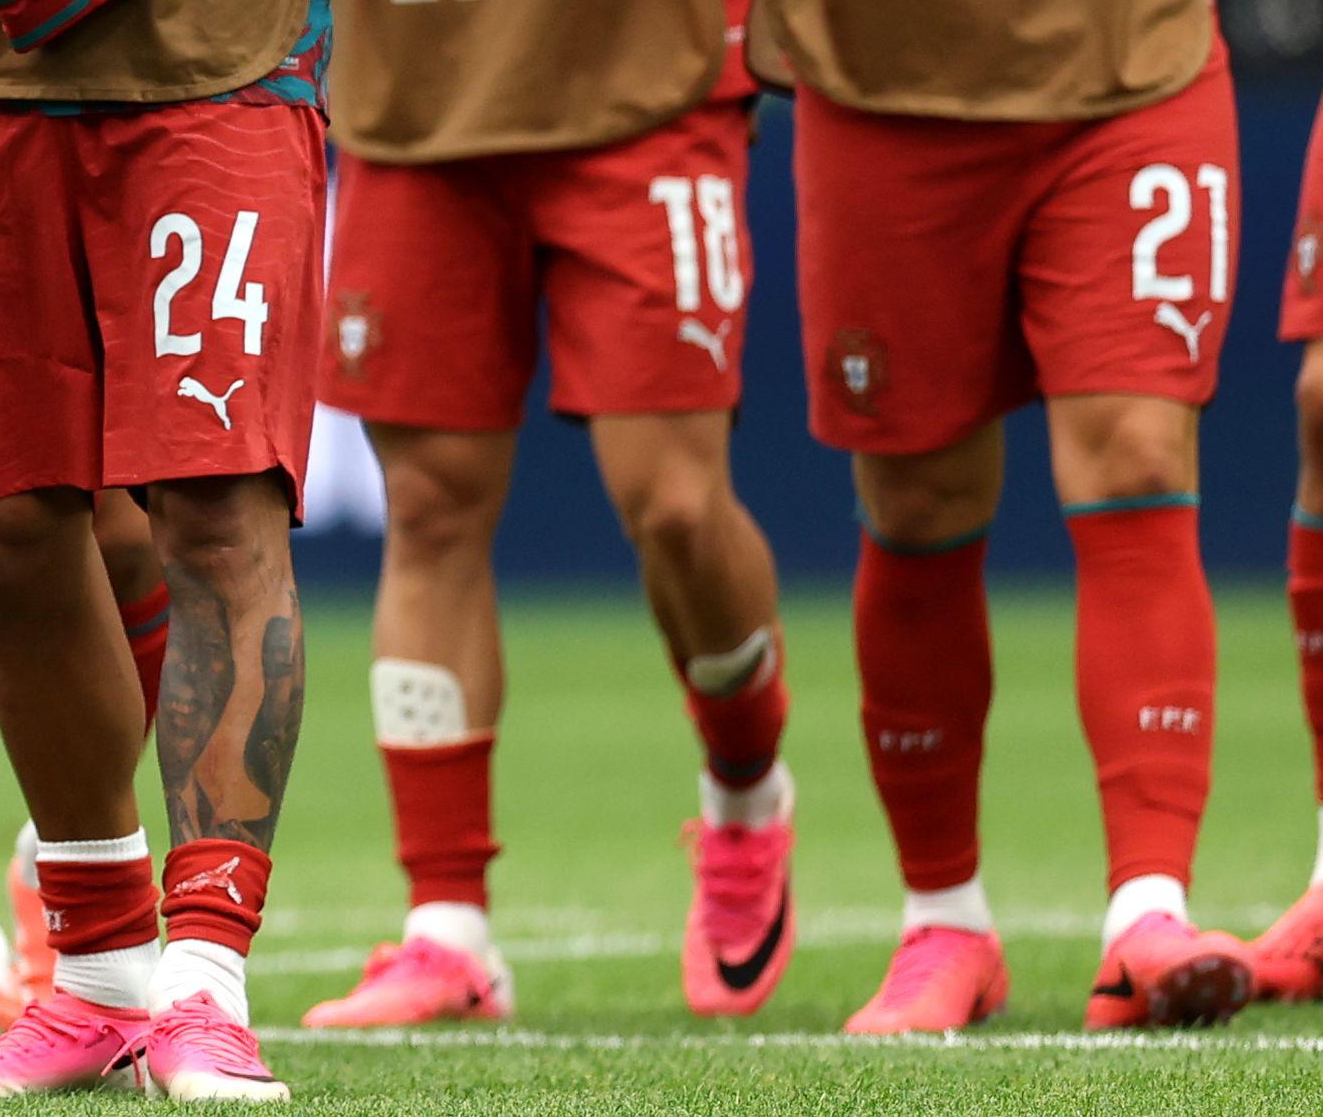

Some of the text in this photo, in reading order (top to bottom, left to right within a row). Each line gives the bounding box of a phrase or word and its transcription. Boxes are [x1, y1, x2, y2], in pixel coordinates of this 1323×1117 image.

[150, 210, 269, 358] 24
[649, 174, 744, 312] 18
[1129, 163, 1229, 302] 21
